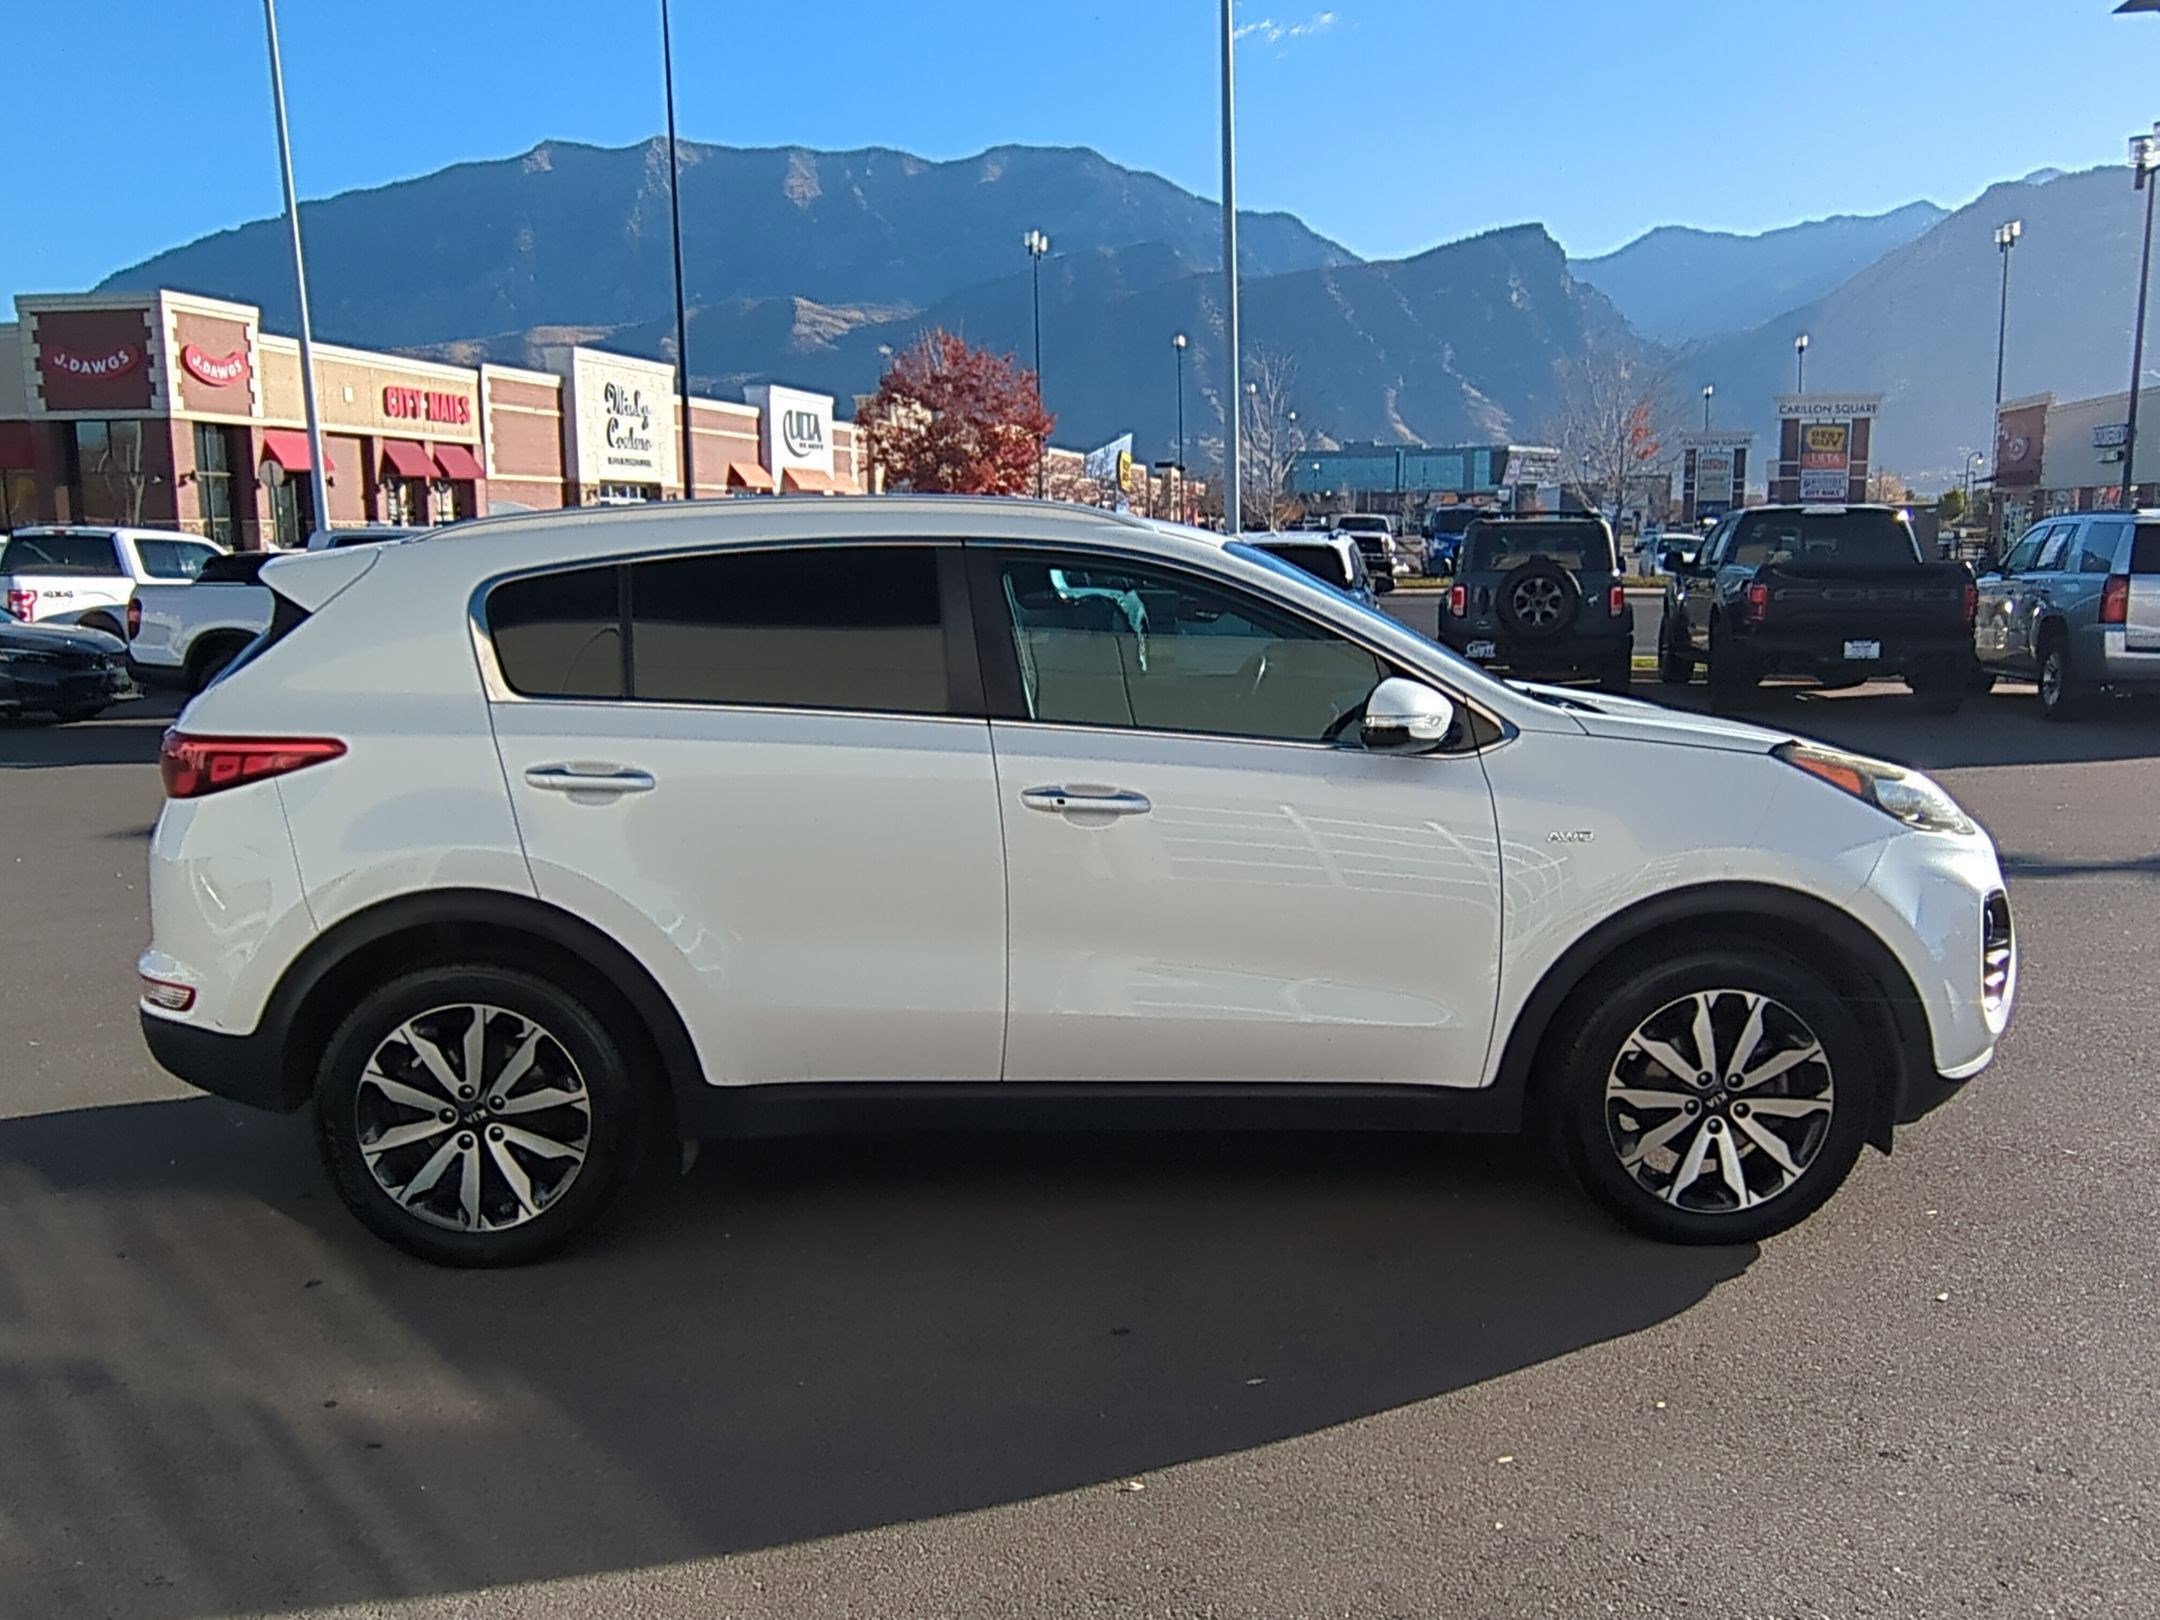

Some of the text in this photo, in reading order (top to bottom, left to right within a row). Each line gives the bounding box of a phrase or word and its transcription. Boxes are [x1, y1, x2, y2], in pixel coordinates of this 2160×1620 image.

[383, 386, 470, 425] CITY NAILS
[1779, 403, 1877, 415] CARILLON SQUARE
[783, 410, 822, 442] ULTA
